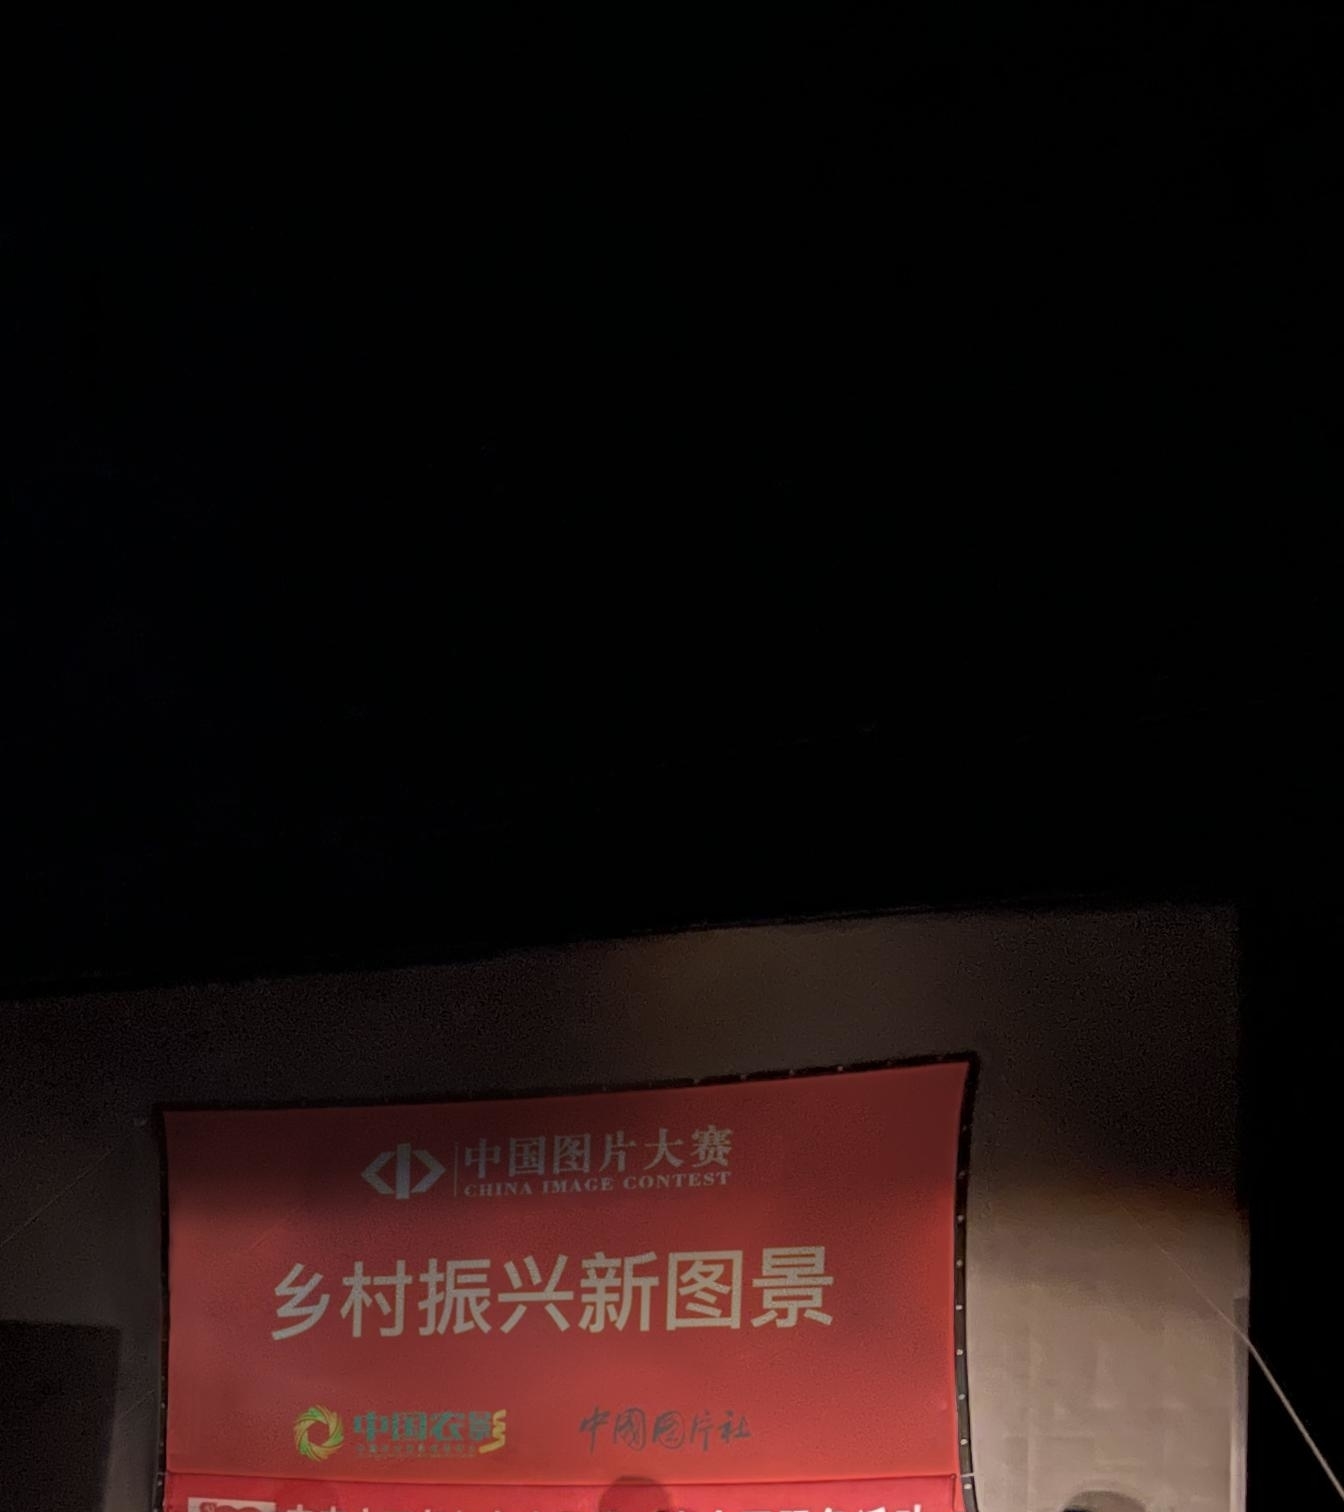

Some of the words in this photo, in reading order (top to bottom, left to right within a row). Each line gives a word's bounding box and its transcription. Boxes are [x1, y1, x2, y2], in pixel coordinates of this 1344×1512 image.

[464, 1123, 734, 1180] 中国图片大赛
[464, 1181, 533, 1198] CHINA
[542, 1178, 614, 1195] IMAGE
[623, 1170, 733, 1190] CONTEST
[271, 1245, 835, 1341] 乡村振兴新图景
